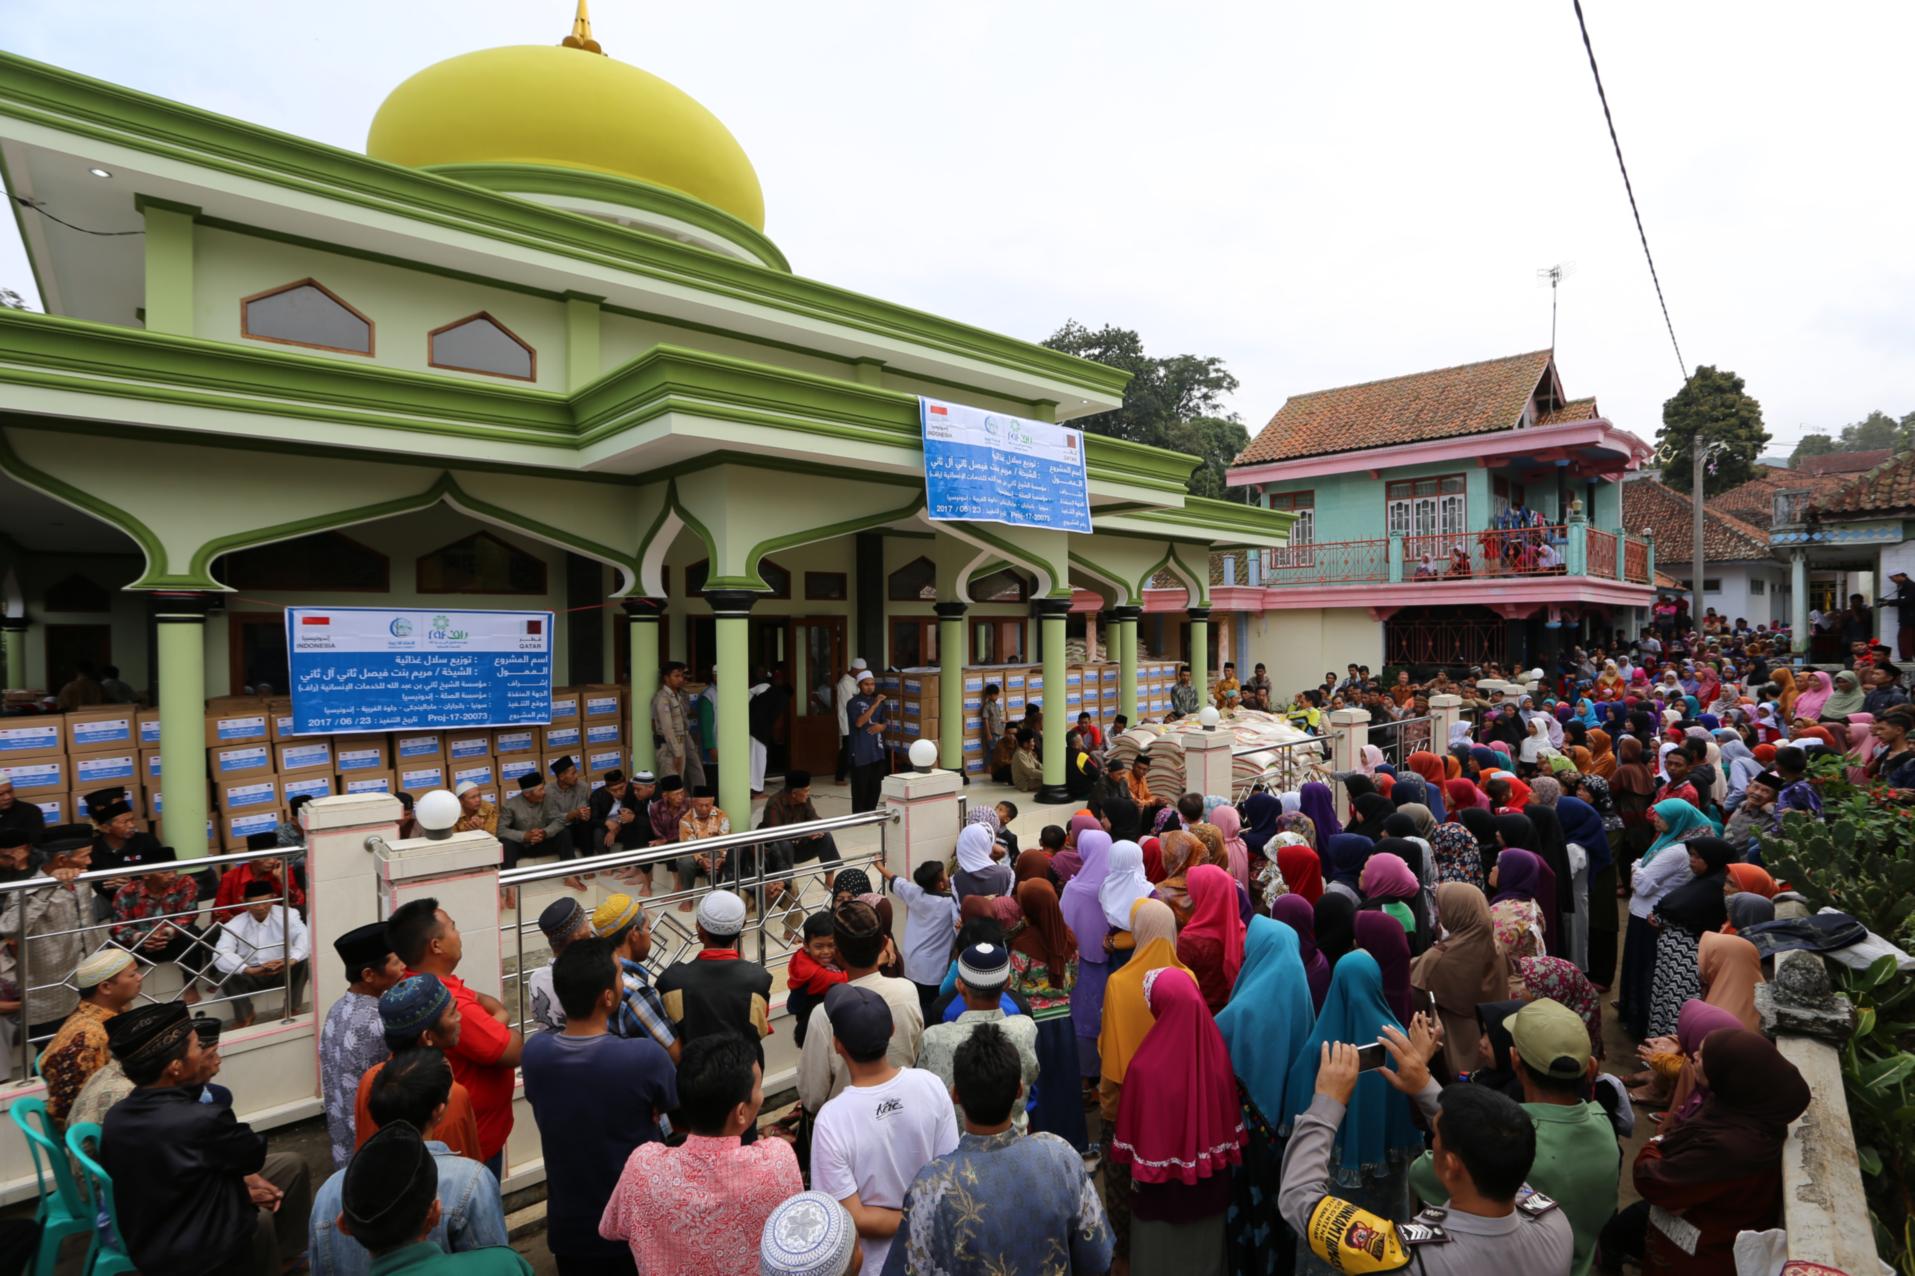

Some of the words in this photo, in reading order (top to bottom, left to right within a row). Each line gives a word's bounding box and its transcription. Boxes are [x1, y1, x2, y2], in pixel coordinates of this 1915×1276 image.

[395, 656, 422, 666] غذائية
[424, 655, 448, 666] سلال
[450, 655, 472, 667] توزيع
[494, 654, 529, 667] المشروع
[530, 655, 548, 666] اسم
[300, 668, 320, 683] ثاني
[322, 667, 336, 680] آل
[337, 668, 358, 682] ثاني
[359, 668, 389, 680] فيصل
[390, 668, 409, 679] بنت
[411, 670, 432, 680] مريم
[442, 667, 472, 678] الشيخة
[439, 681, 460, 690] الشيخ
[461, 680, 487, 689] مؤسسة
[461, 692, 487, 700] مؤسسة
[308, 718, 331, 727] 2017
[428, 712, 488, 722] Proj-17-20073
